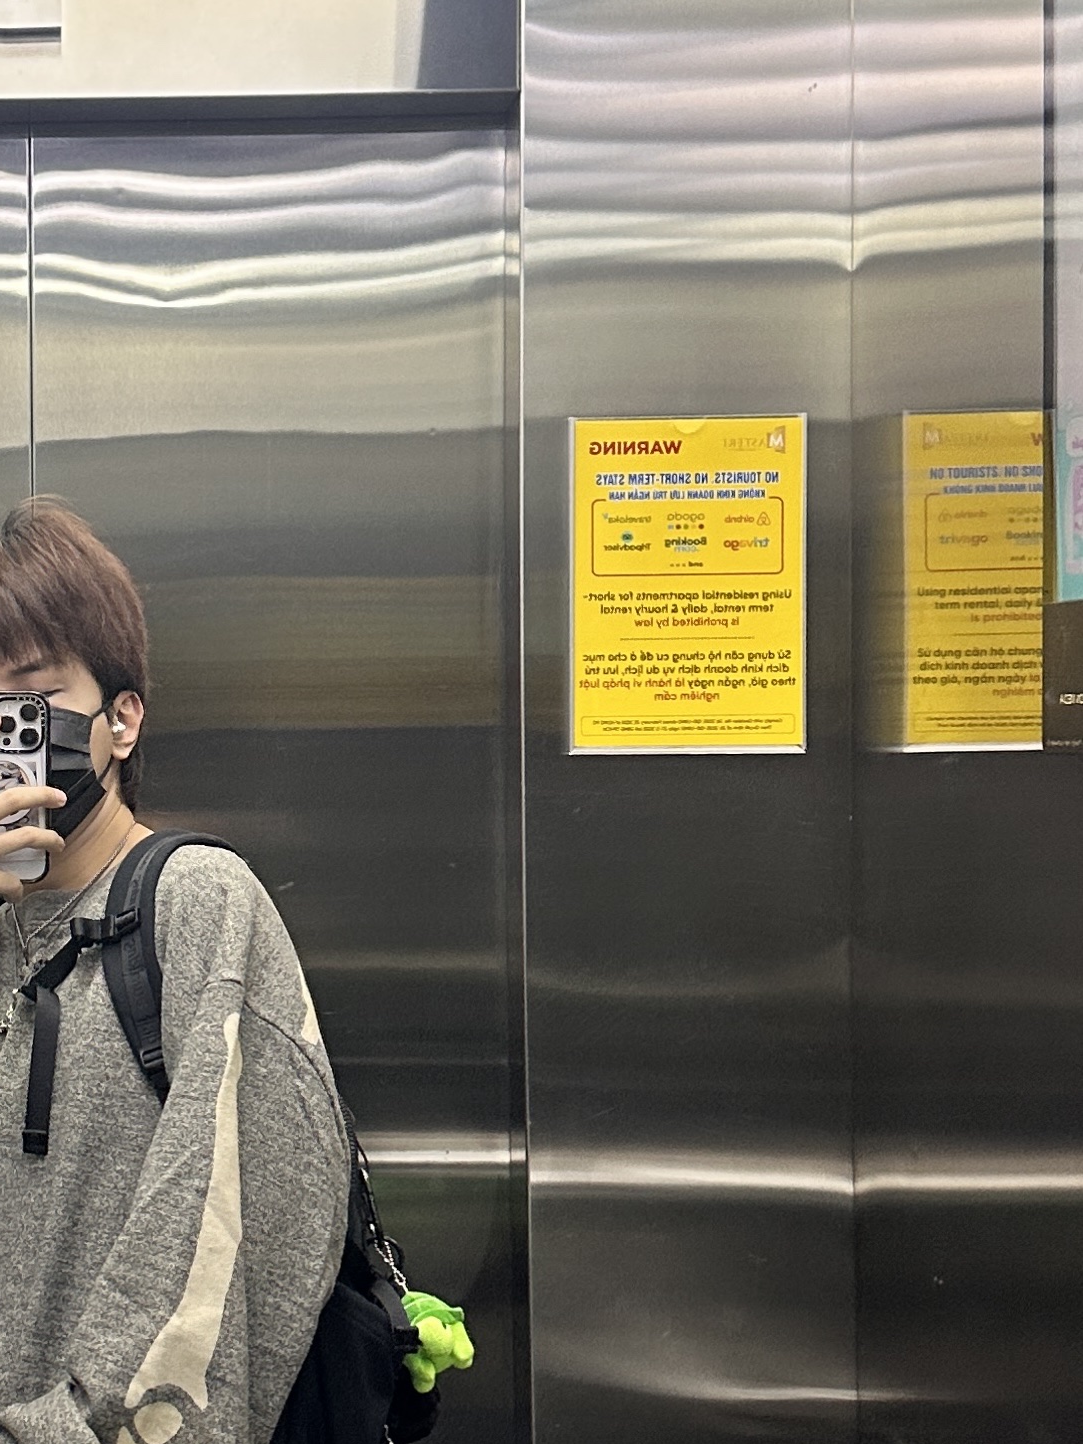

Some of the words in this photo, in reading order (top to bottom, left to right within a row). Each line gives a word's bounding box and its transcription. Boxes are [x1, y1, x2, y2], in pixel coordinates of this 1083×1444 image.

[930, 468, 944, 479] NO
[1005, 466, 1018, 477] NO
[1006, 530, 1043, 539] Bookin
[917, 587, 946, 597] Using
[949, 586, 1011, 596] residential
[935, 602, 960, 610] term
[1005, 599, 1032, 609] daily
[913, 676, 937, 684] theo
